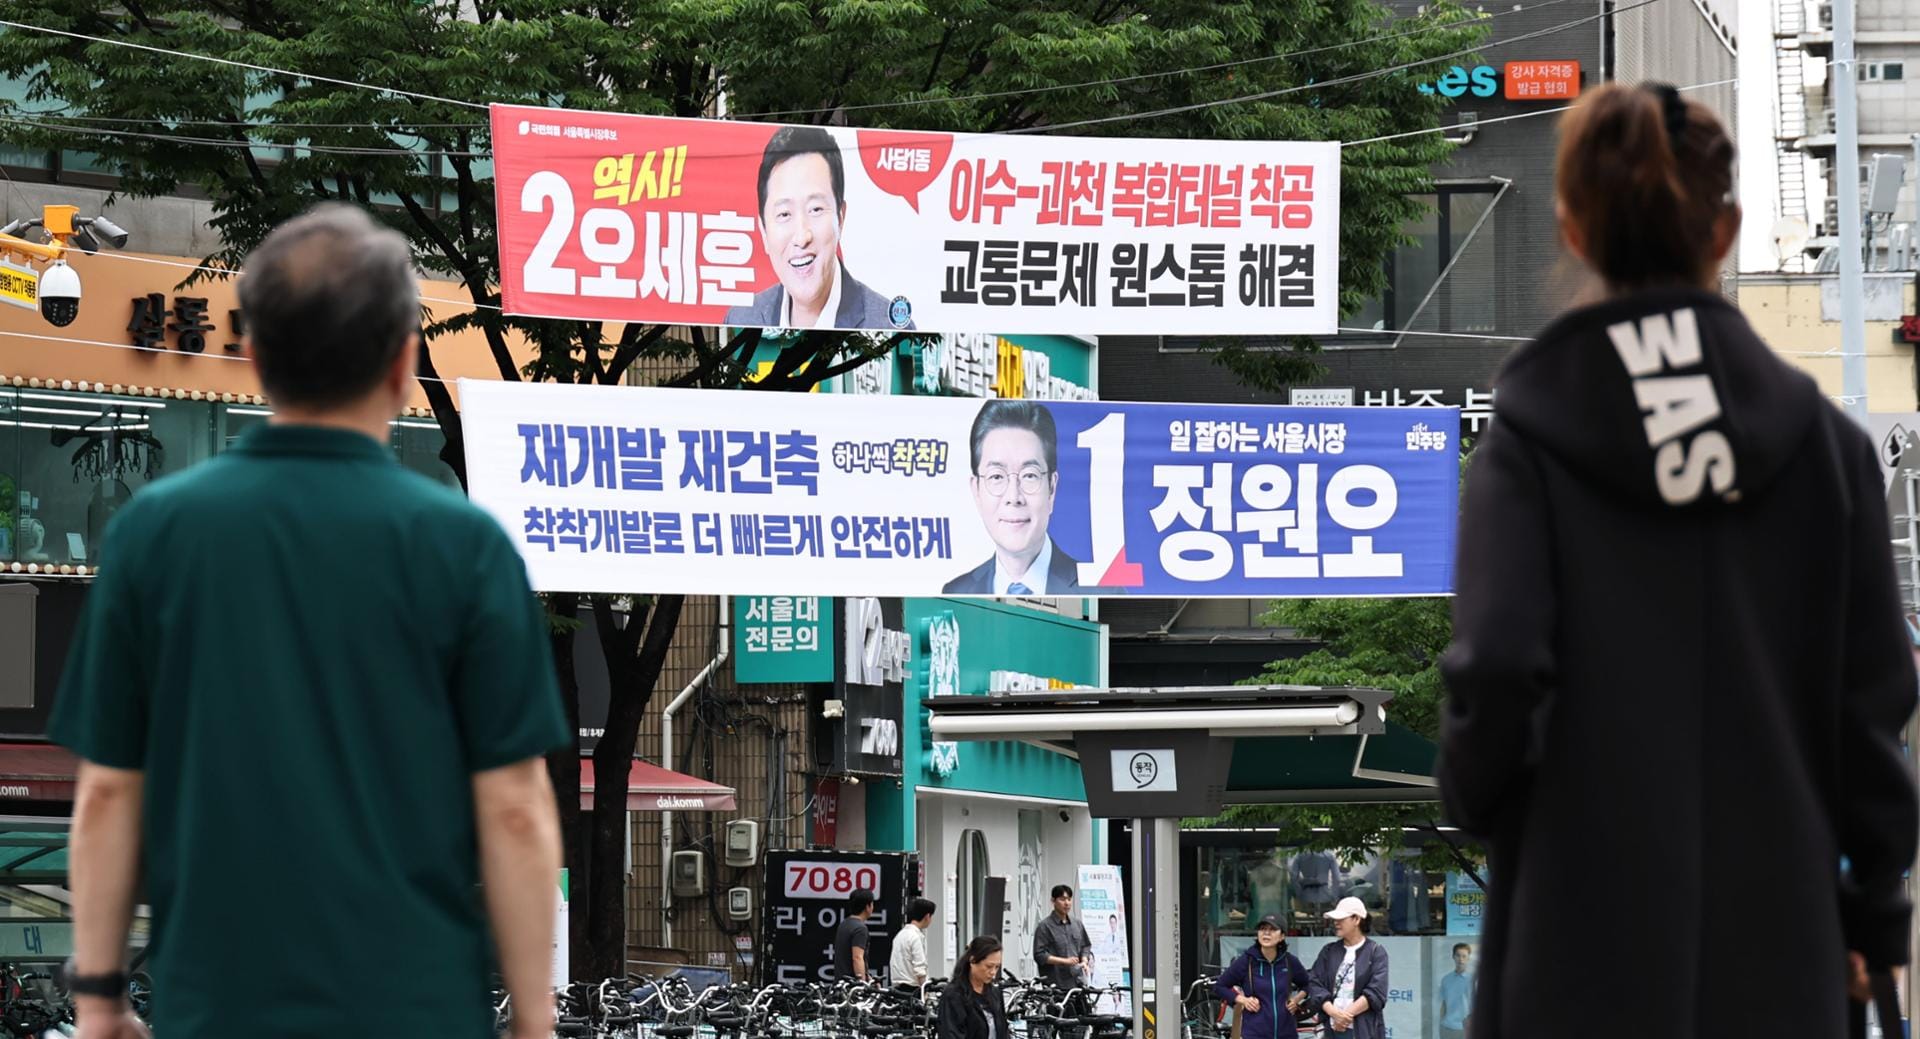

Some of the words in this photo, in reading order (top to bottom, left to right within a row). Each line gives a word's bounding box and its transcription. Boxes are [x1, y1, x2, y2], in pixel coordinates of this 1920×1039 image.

[1511, 65, 1535, 79] 강사
[1538, 64, 1573, 79] 자격증
[1517, 82, 1540, 95] 발급
[1544, 82, 1567, 95] 협회
[531, 123, 561, 137] 국민의힘
[563, 126, 618, 141] 서울특별시장후보
[876, 147, 931, 173] 사당1동
[592, 144, 688, 206] 역시!
[948, 157, 1107, 228] 이수-과천
[1112, 161, 1244, 229] 복합터널
[1249, 163, 1314, 229] 착공
[520, 170, 578, 297] 2
[579, 208, 756, 307] 오세훈
[940, 239, 1099, 307] 교통문제
[1110, 243, 1226, 308] 원스톱
[1239, 243, 1315, 308] 해결
[1606, 307, 1736, 506] WAS
[1170, 420, 1191, 452] 일
[1194, 420, 1261, 453] 잘하는
[1263, 422, 1347, 455] 서울시장
[1405, 431, 1447, 452] 민주당
[518, 423, 666, 492] 재개발
[678, 429, 819, 496] 재건축
[833, 441, 891, 474] 하나씩
[892, 439, 948, 477] 착착!
[1077, 412, 1144, 587] 1
[524, 507, 685, 555] 착착개발로
[692, 513, 722, 556] 더
[731, 514, 824, 557] 빠르게
[831, 516, 952, 559] 안전하게
[1149, 462, 1404, 582] 정원오
[745, 597, 818, 622] 서울대
[745, 626, 818, 652] 전문의
[1135, 761, 1153, 773] 동작
[656, 795, 704, 809] dal.komm
[789, 866, 877, 893] 7080
[1388, 989, 1414, 1002] 우대
